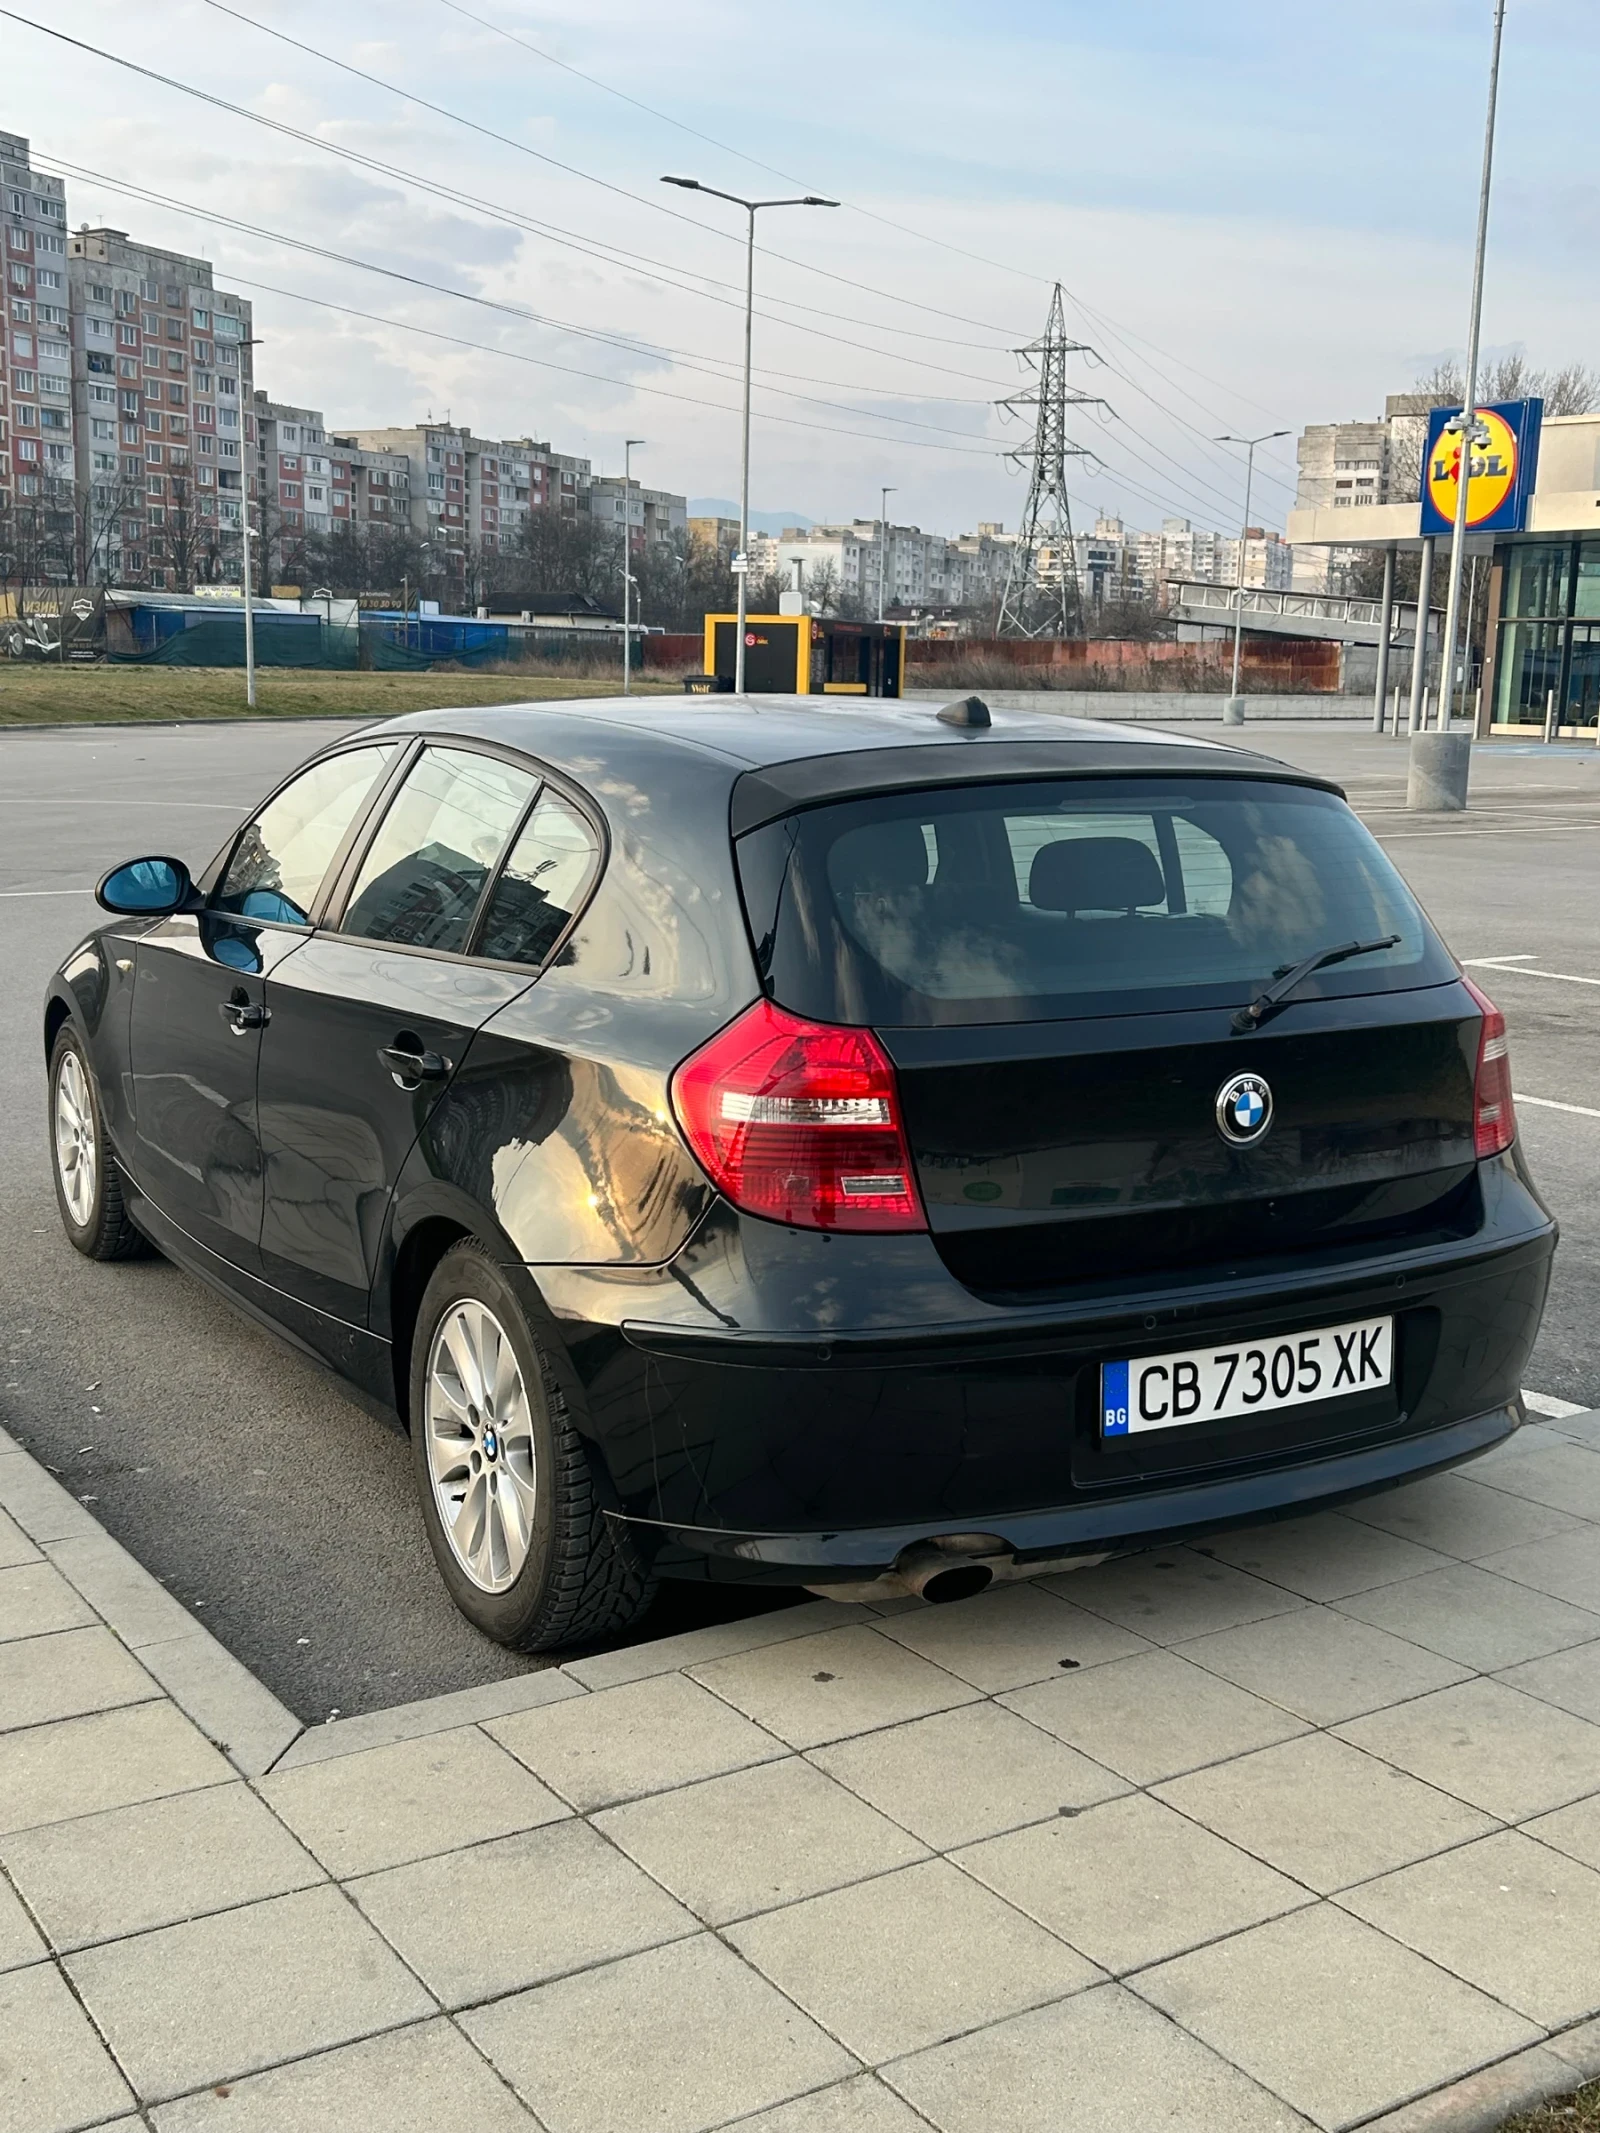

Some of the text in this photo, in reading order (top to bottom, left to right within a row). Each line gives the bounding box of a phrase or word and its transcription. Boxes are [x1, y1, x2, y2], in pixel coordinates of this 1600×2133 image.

[1229, 1081, 1267, 1103] BMW
[1139, 1326, 1383, 1421] CB 7305 XK
[1105, 1407, 1127, 1427] BG
